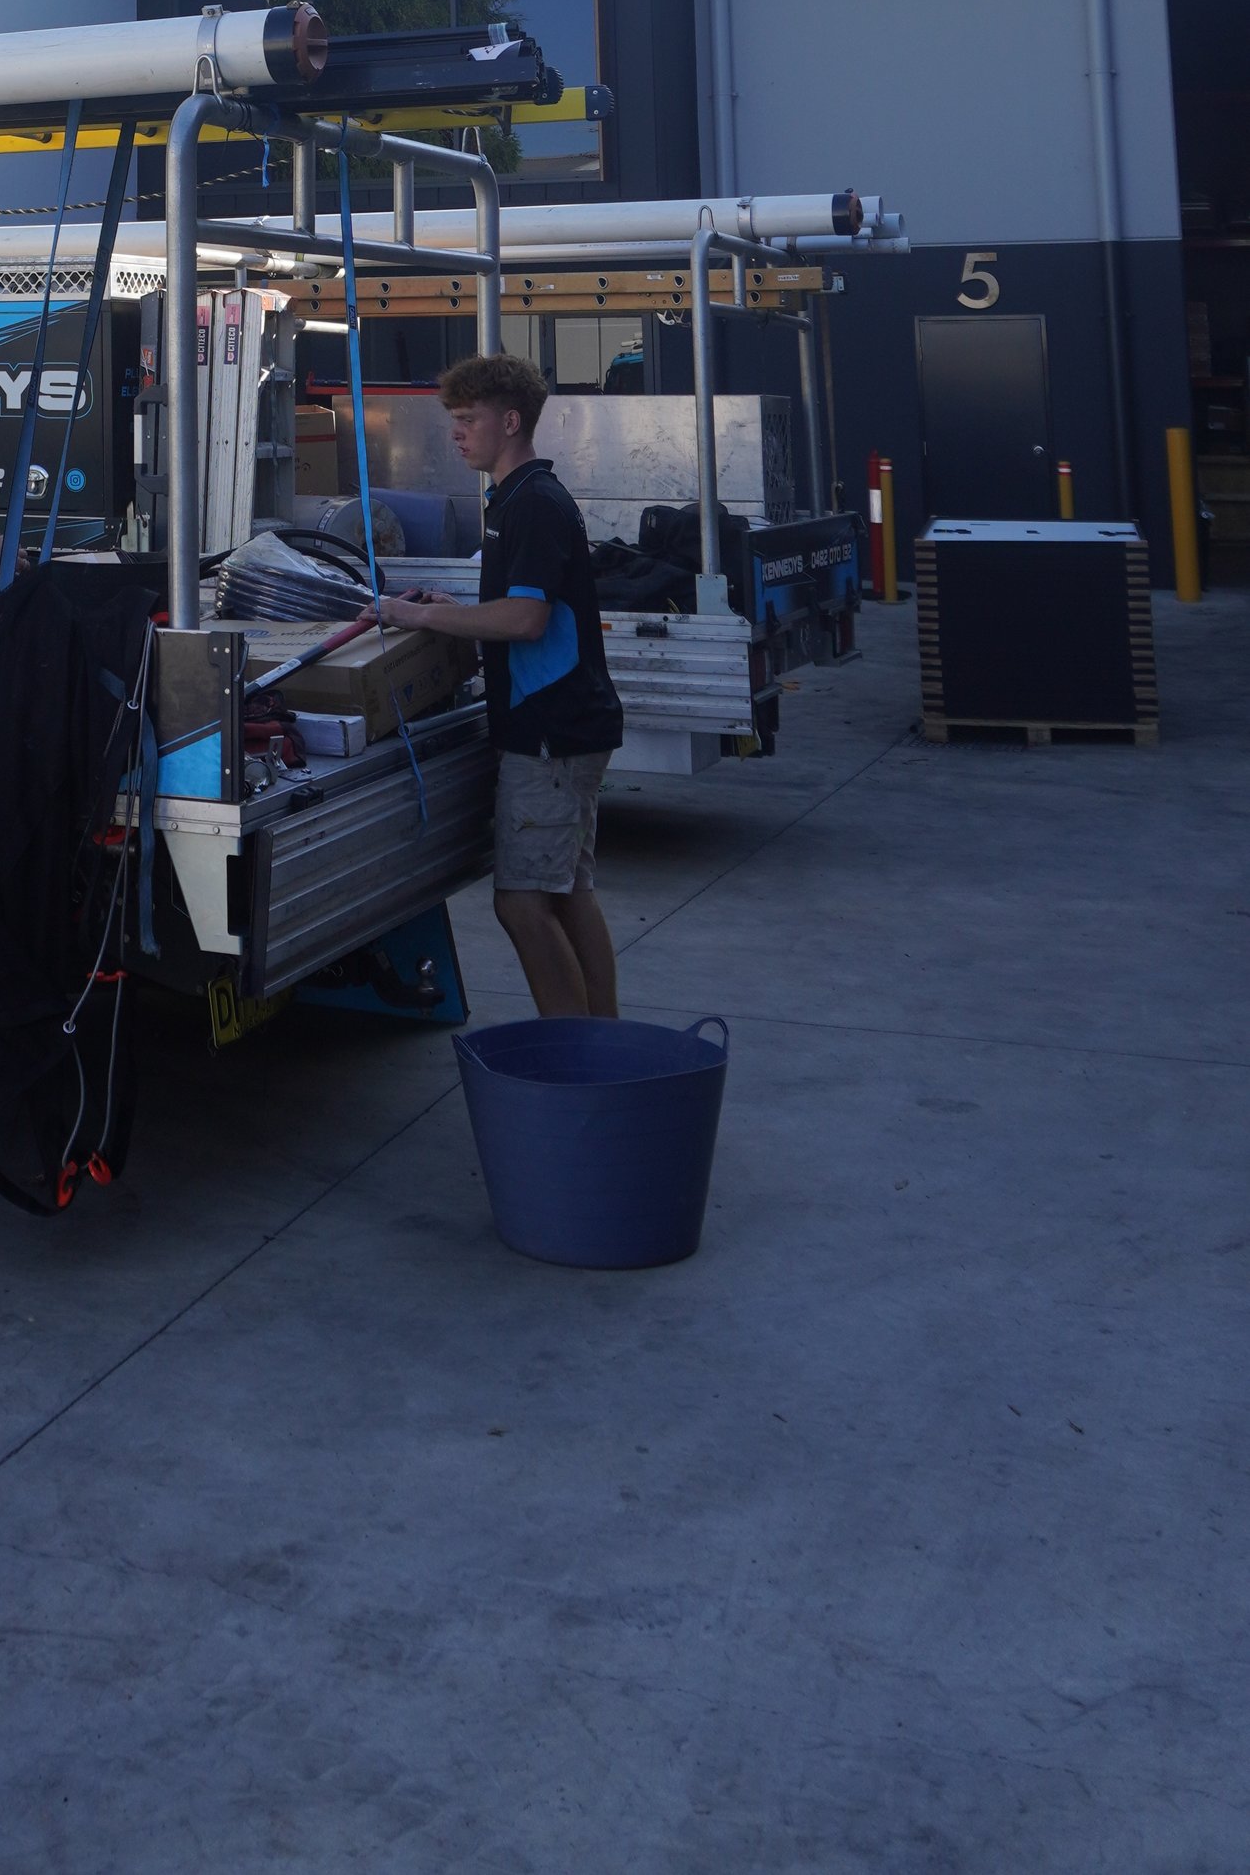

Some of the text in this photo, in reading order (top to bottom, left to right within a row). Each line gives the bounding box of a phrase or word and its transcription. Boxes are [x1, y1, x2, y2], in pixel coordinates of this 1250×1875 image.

[956, 252, 1000, 309] 5
[197, 328, 206, 353] CITECO
[227, 327, 236, 352] CITECO
[762, 554, 804, 582] KENNEDYS
[811, 549, 829, 569] 0482
[830, 546, 842, 565] 070
